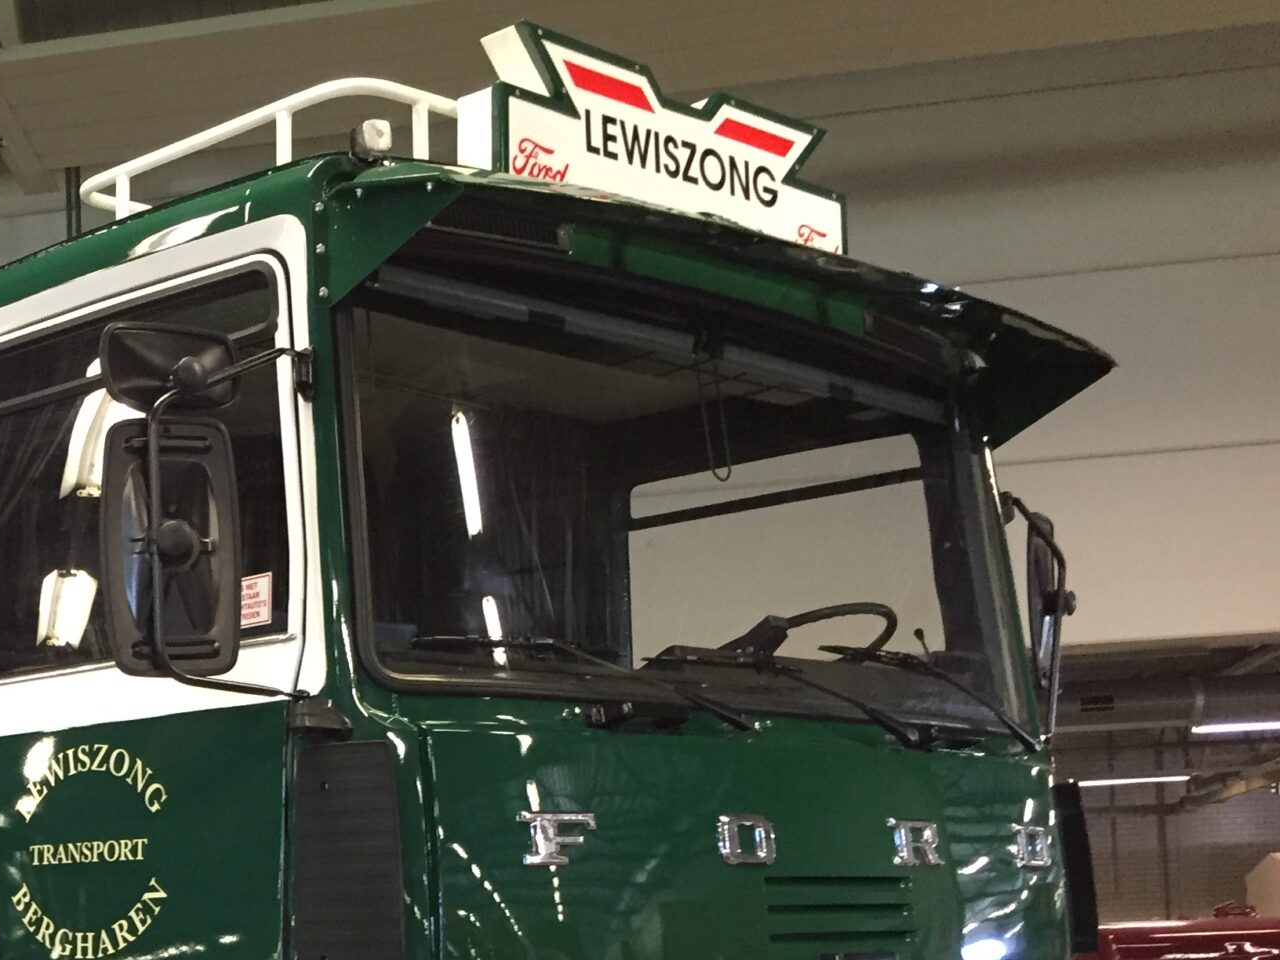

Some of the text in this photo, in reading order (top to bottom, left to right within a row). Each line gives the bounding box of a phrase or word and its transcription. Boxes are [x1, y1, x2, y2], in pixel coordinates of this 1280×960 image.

[512, 138, 569, 184] Ford
[584, 109, 778, 208] LEWISZONG
[14, 744, 168, 823] LEWISZONG
[29, 838, 148, 866] TRANSPORT
[11, 877, 169, 960] BERGHAREN
